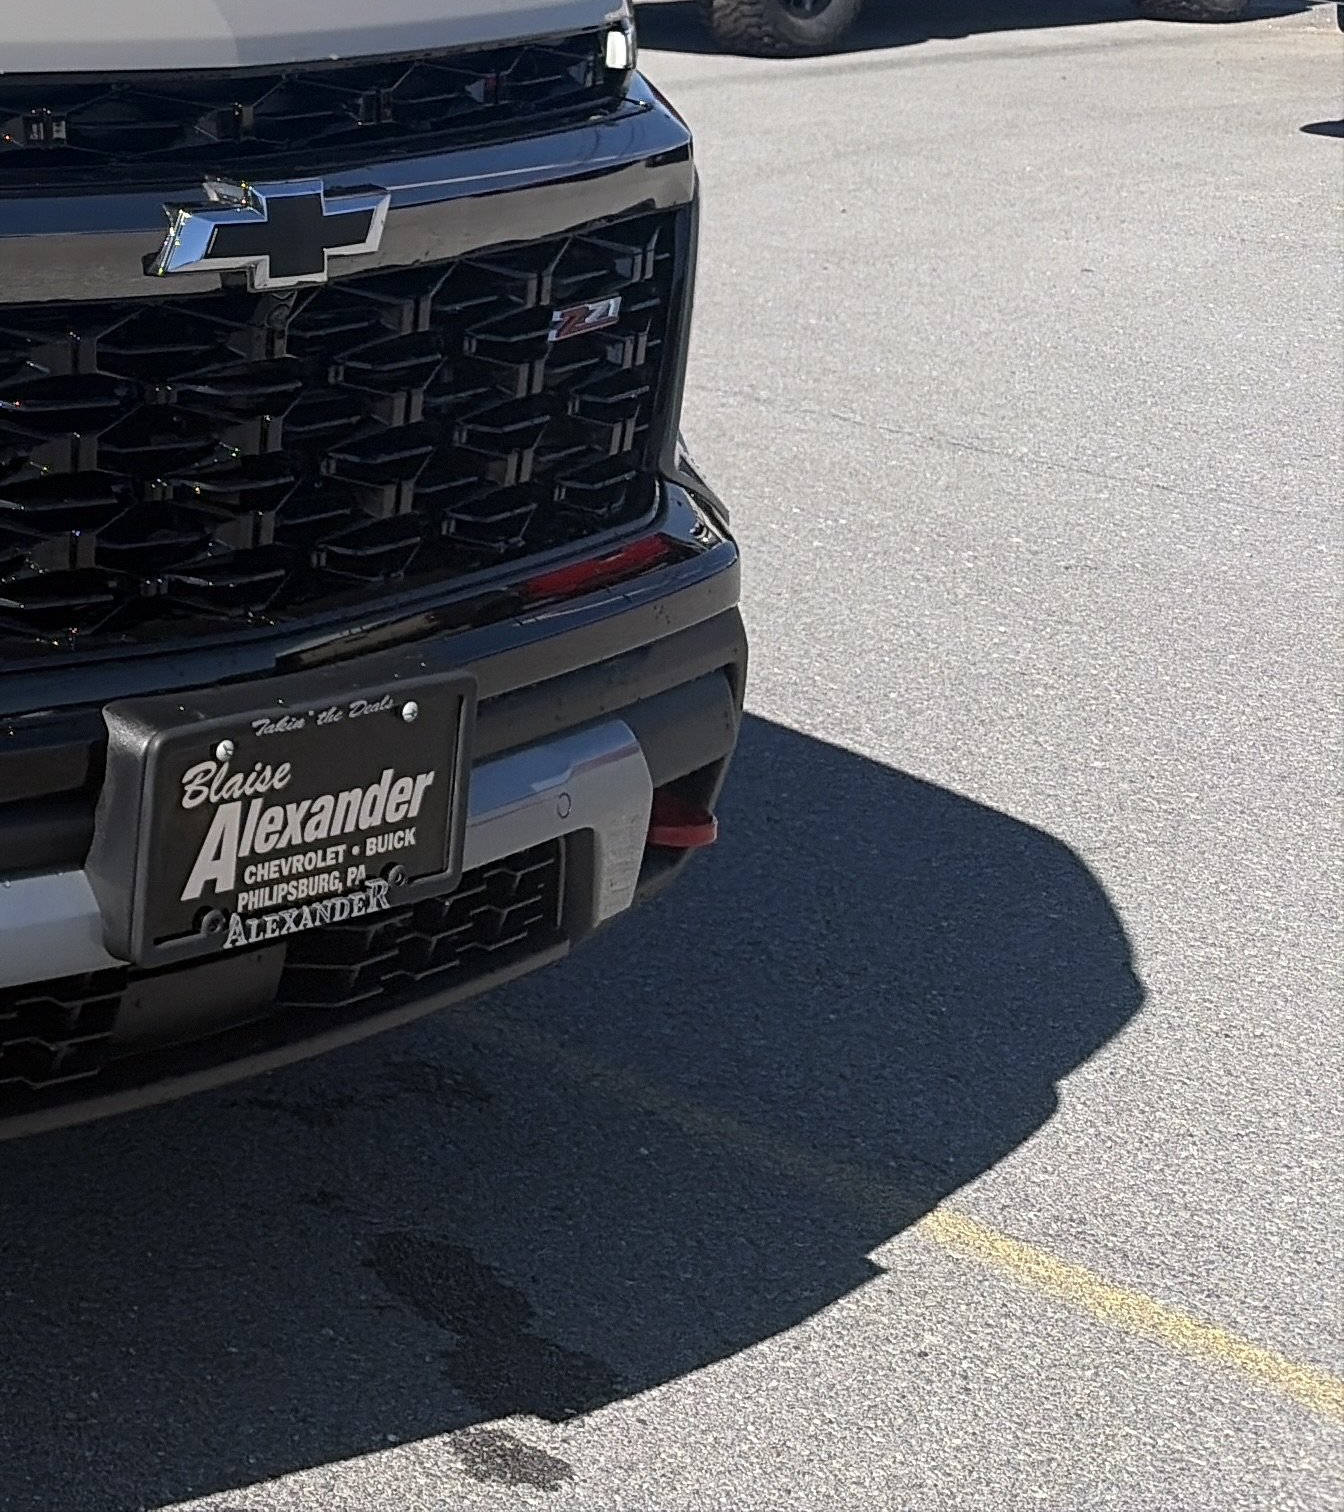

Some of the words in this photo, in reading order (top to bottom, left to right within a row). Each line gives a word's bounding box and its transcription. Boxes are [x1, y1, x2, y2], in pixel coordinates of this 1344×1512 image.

[316, 706, 343, 726] the
[348, 694, 394, 719] Deals
[181, 760, 292, 809] Blaise
[180, 768, 436, 901] Alexander
[244, 844, 347, 885] CHEVROLET
[365, 827, 416, 857] BUICK
[223, 879, 392, 950] ALEXANDER
[237, 872, 343, 914] PHILIPSBURG,
[346, 864, 367, 887] PA
